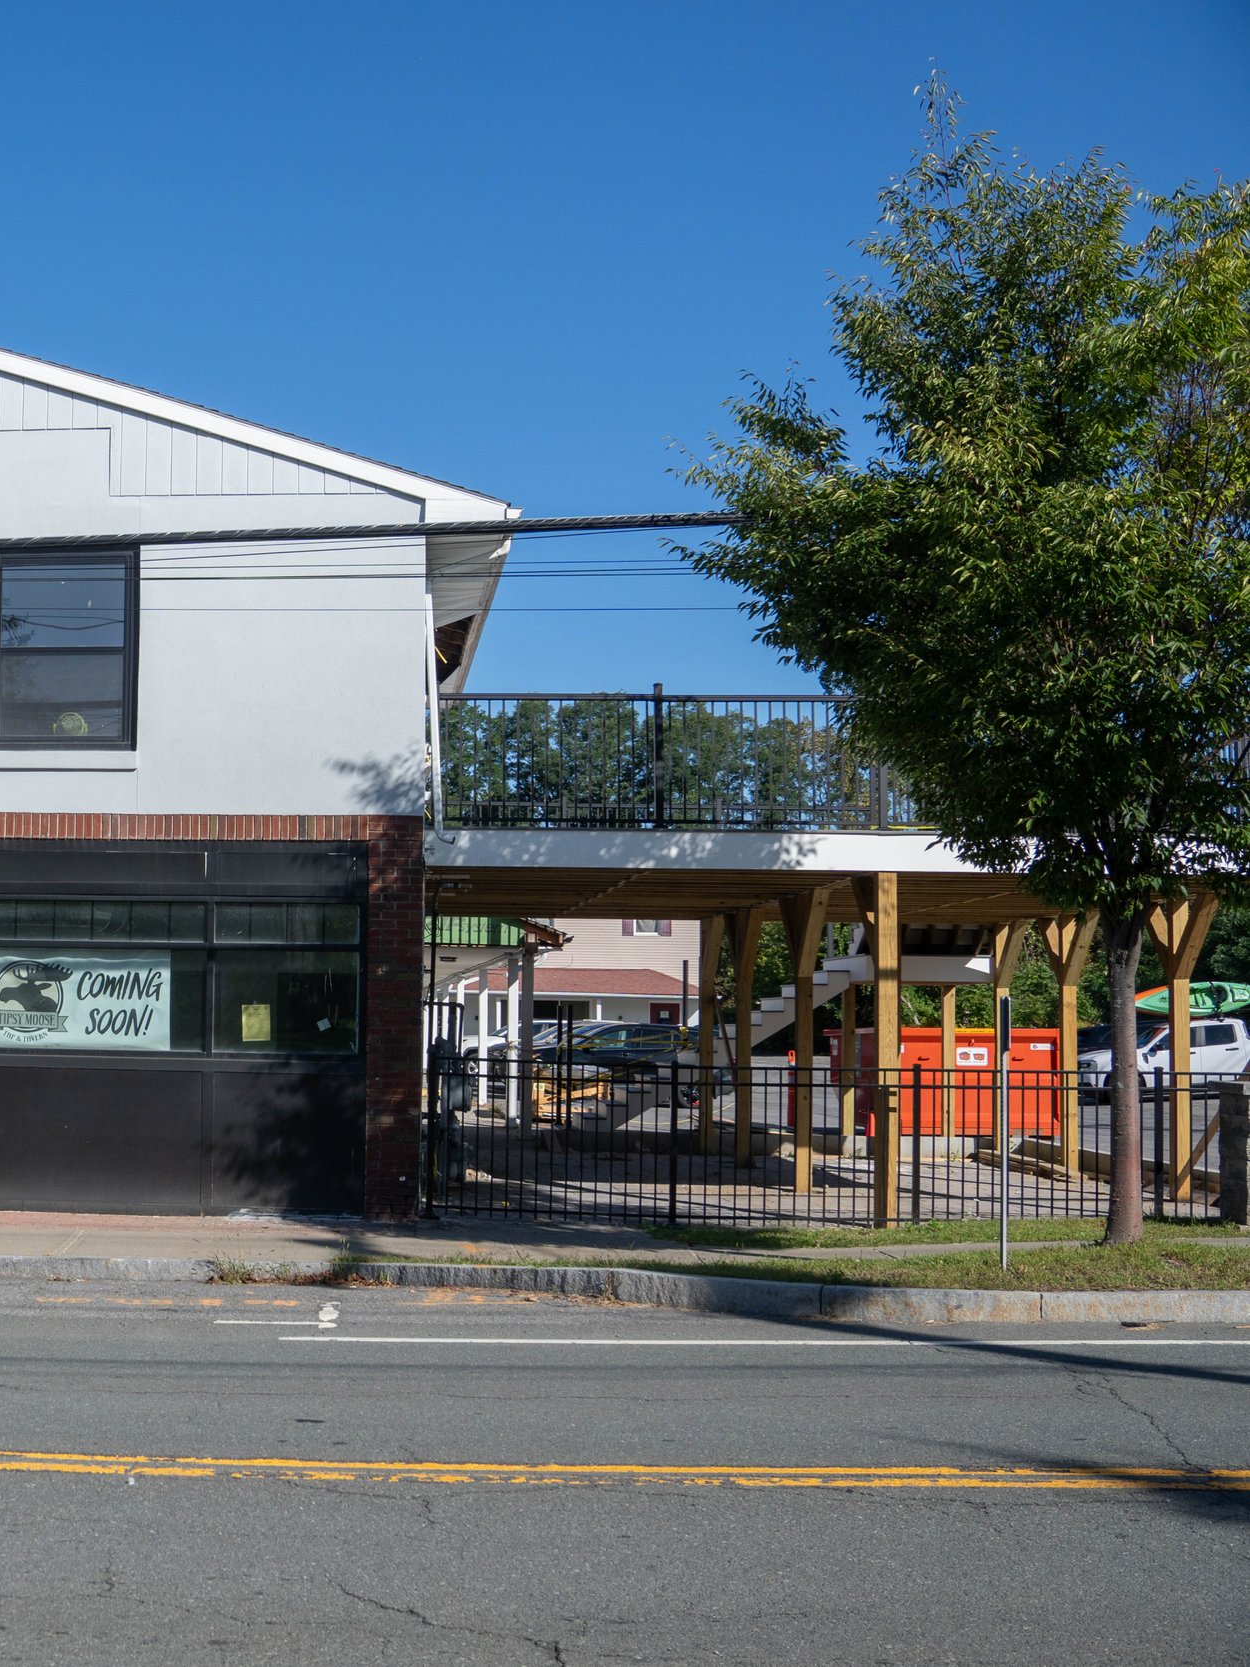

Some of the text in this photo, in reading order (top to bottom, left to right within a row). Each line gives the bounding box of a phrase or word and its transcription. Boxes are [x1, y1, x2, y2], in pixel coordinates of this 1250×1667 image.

[76, 967, 164, 1002] COMING
[25, 1013, 56, 1026] MOOSE
[84, 1004, 154, 1037] SOON!
[22, 1031, 48, 1042] TAVERN
